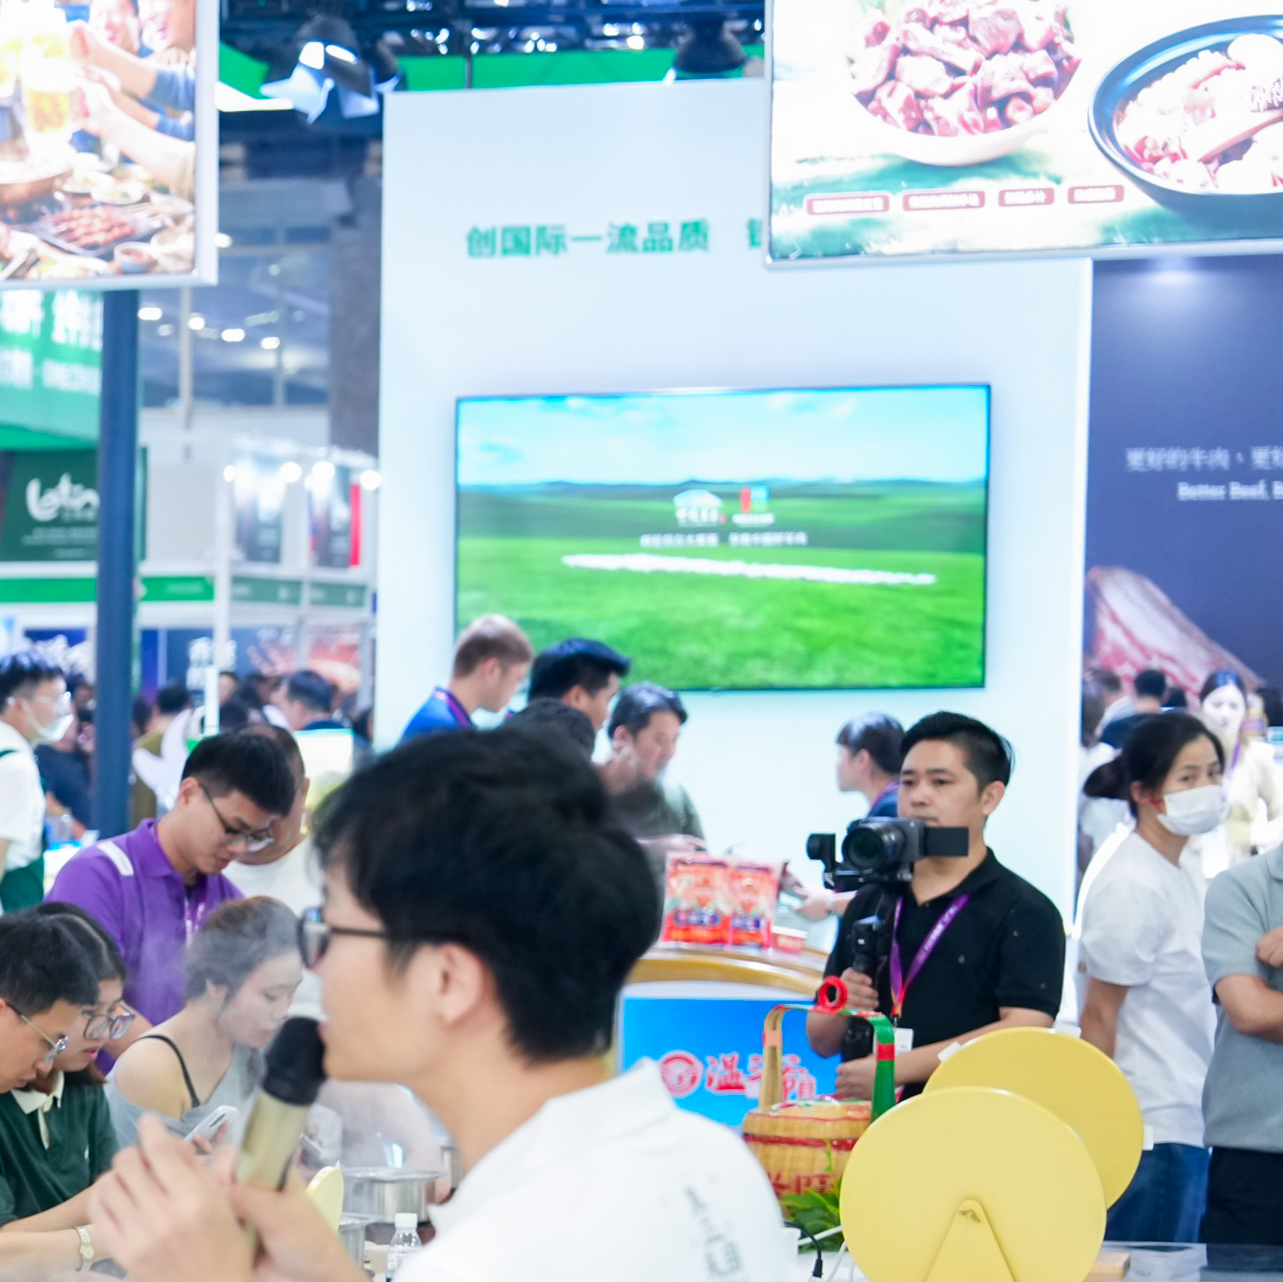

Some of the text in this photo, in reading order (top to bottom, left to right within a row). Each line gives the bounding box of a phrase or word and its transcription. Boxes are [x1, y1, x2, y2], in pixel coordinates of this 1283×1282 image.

[466, 220, 711, 258] 创国际一流品质
[1177, 482, 1227, 501] Better
